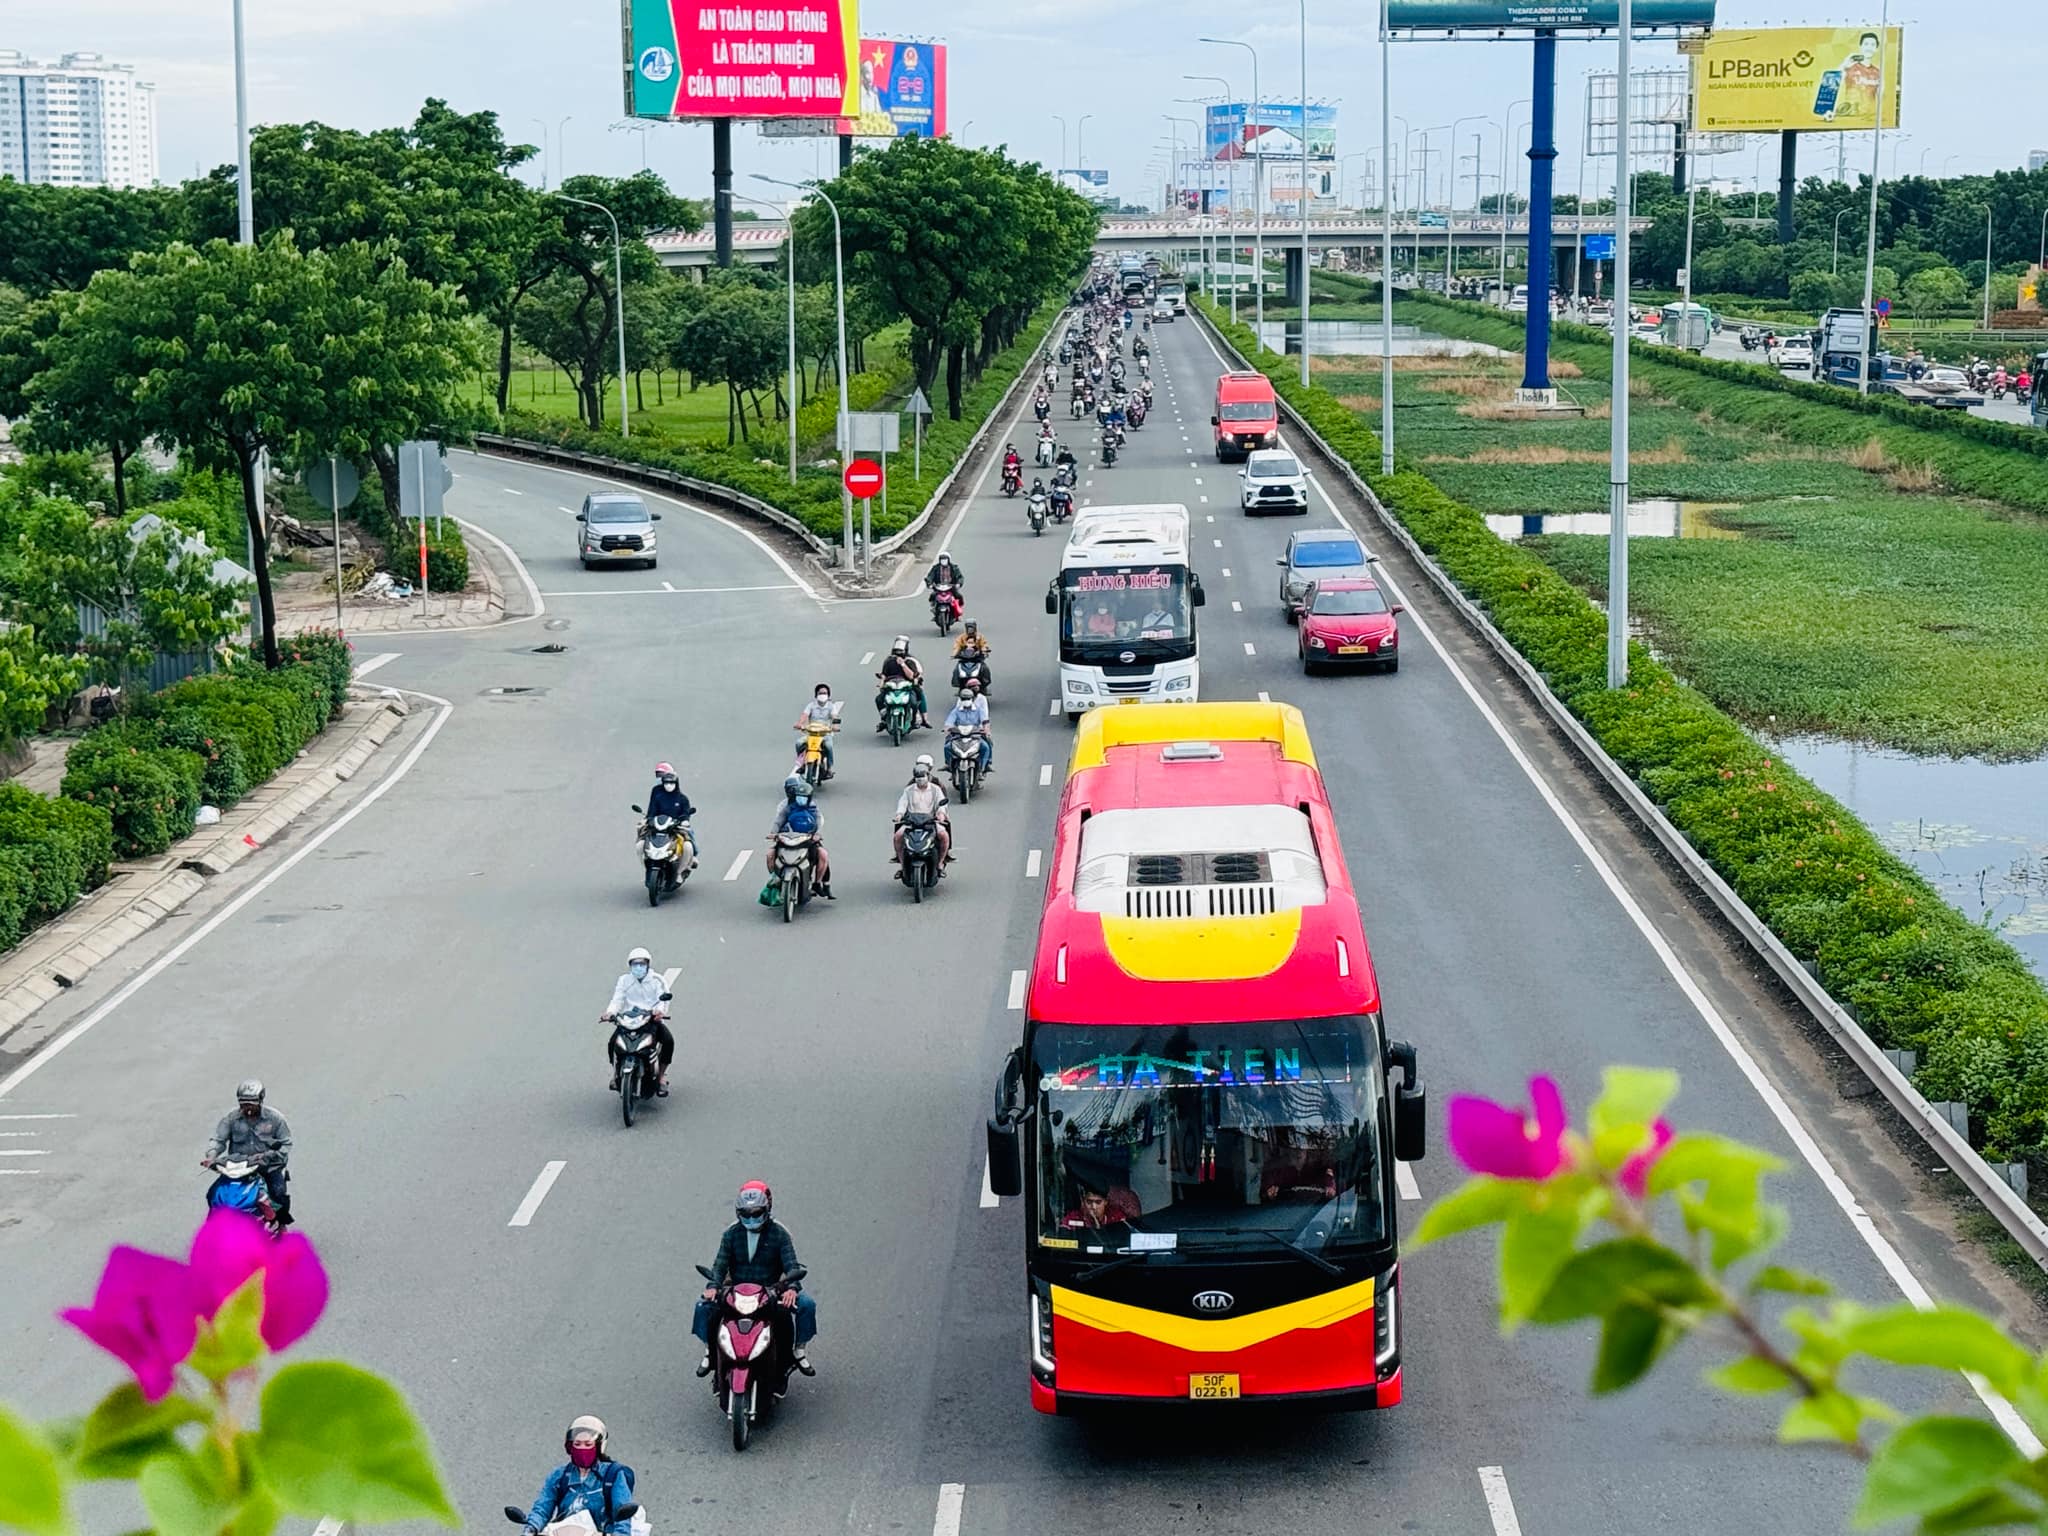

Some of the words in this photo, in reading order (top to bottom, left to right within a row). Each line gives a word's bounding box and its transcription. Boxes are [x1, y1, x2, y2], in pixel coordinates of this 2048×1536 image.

[698, 9, 717, 31] AN
[719, 5, 752, 31] TOÀN
[755, 10, 784, 32] GIAO
[787, 6, 828, 33] THÔNG
[712, 38, 730, 65] LÀ
[731, 38, 772, 65] TRÁCH
[774, 39, 815, 70] NHIỆM
[1709, 58, 1792, 79] LPBank
[687, 68, 713, 98] CỦA
[716, 75, 741, 102] MỌI
[743, 71, 787, 100] NGƯỜI,
[788, 76, 813, 102] MỌI
[815, 73, 842, 98] NHÀ
[897, 76, 924, 94] 2-9
[1181, 159, 1241, 171] mobione
[1078, 570, 1126, 591] HÙNG
[1200, 1296, 1227, 1308] KIA
[1204, 1375, 1225, 1386] 50F
